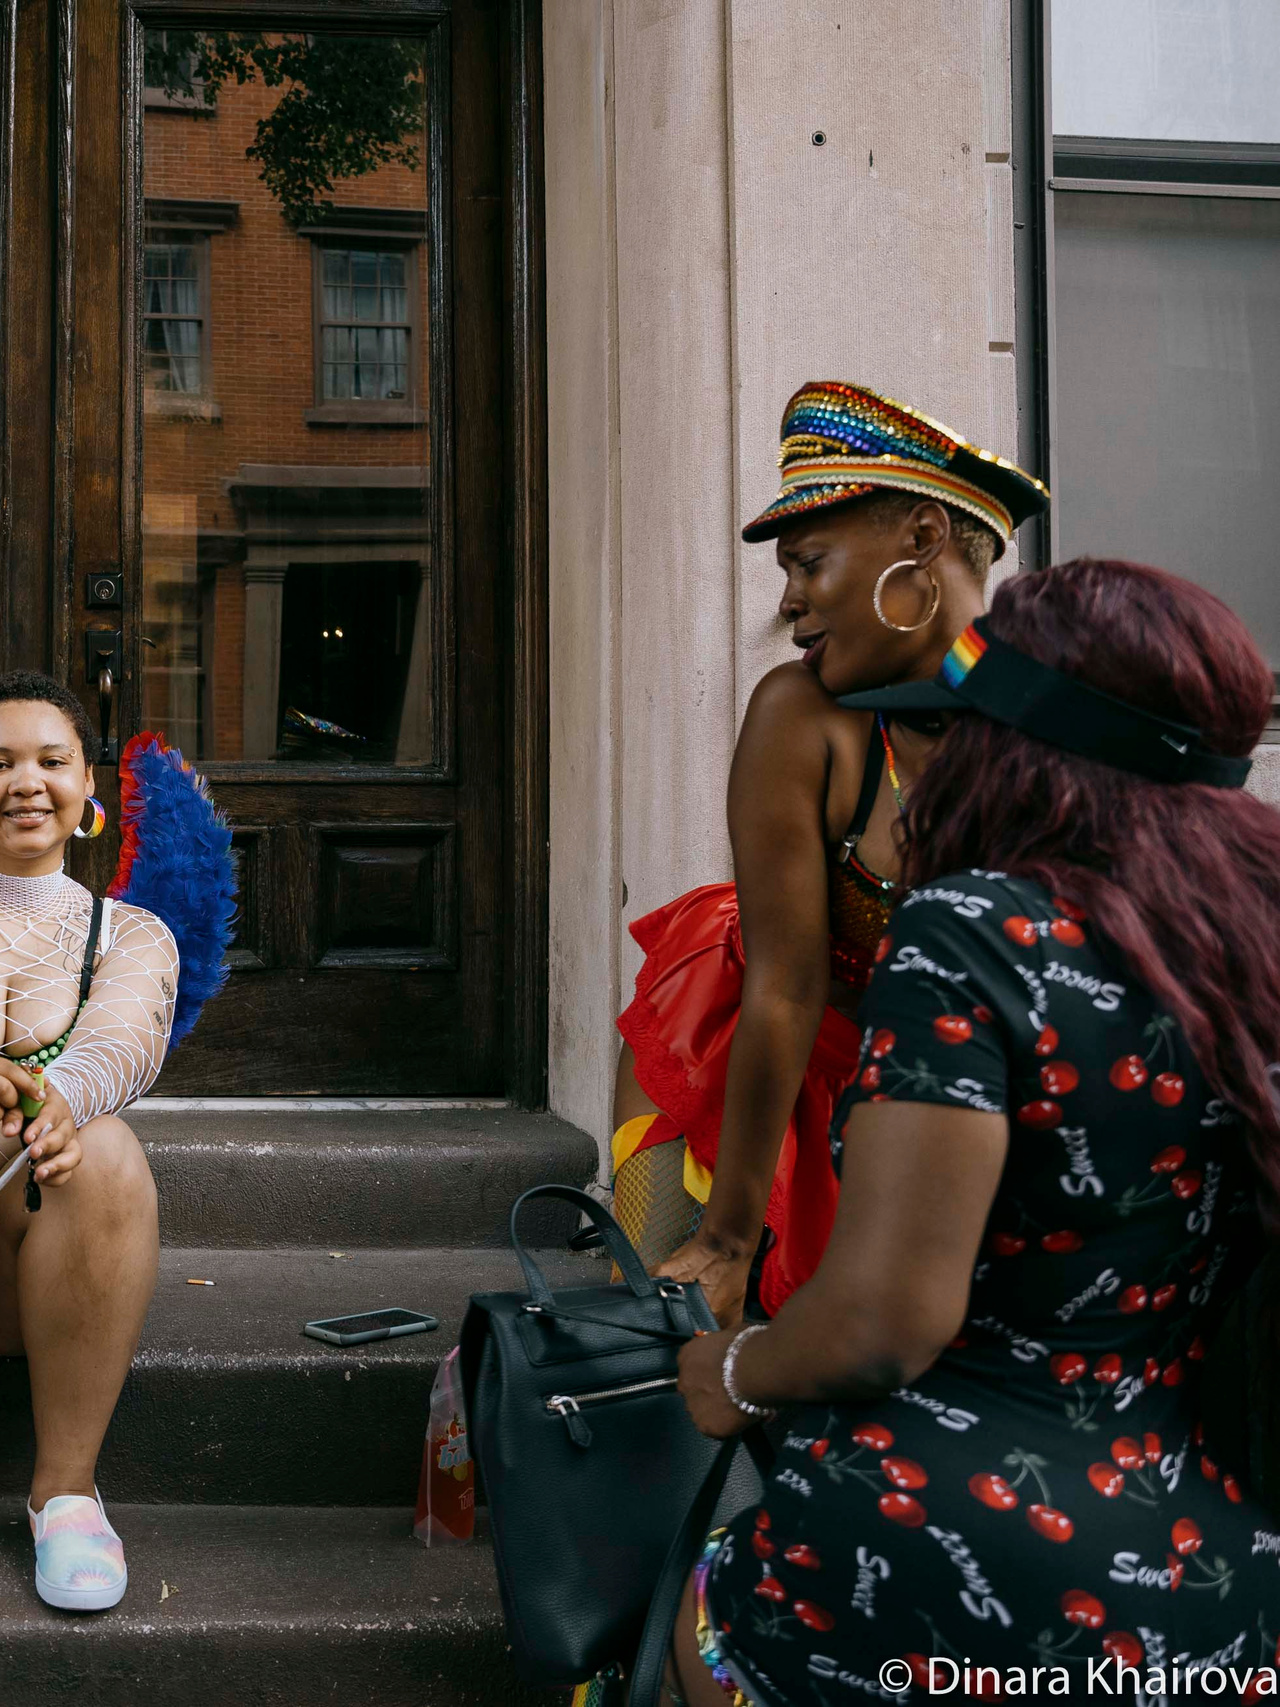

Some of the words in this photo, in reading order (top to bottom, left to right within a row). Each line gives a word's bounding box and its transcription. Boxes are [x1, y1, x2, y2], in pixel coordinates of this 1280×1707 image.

[889, 946, 968, 983] Sweet
[1042, 961, 1126, 1011] Sweet
[1055, 1127, 1104, 1197] Sweet
[1055, 1267, 1120, 1322] Sweet
[851, 1546, 891, 1619] Sweet
[926, 1525, 1013, 1628] Sweet
